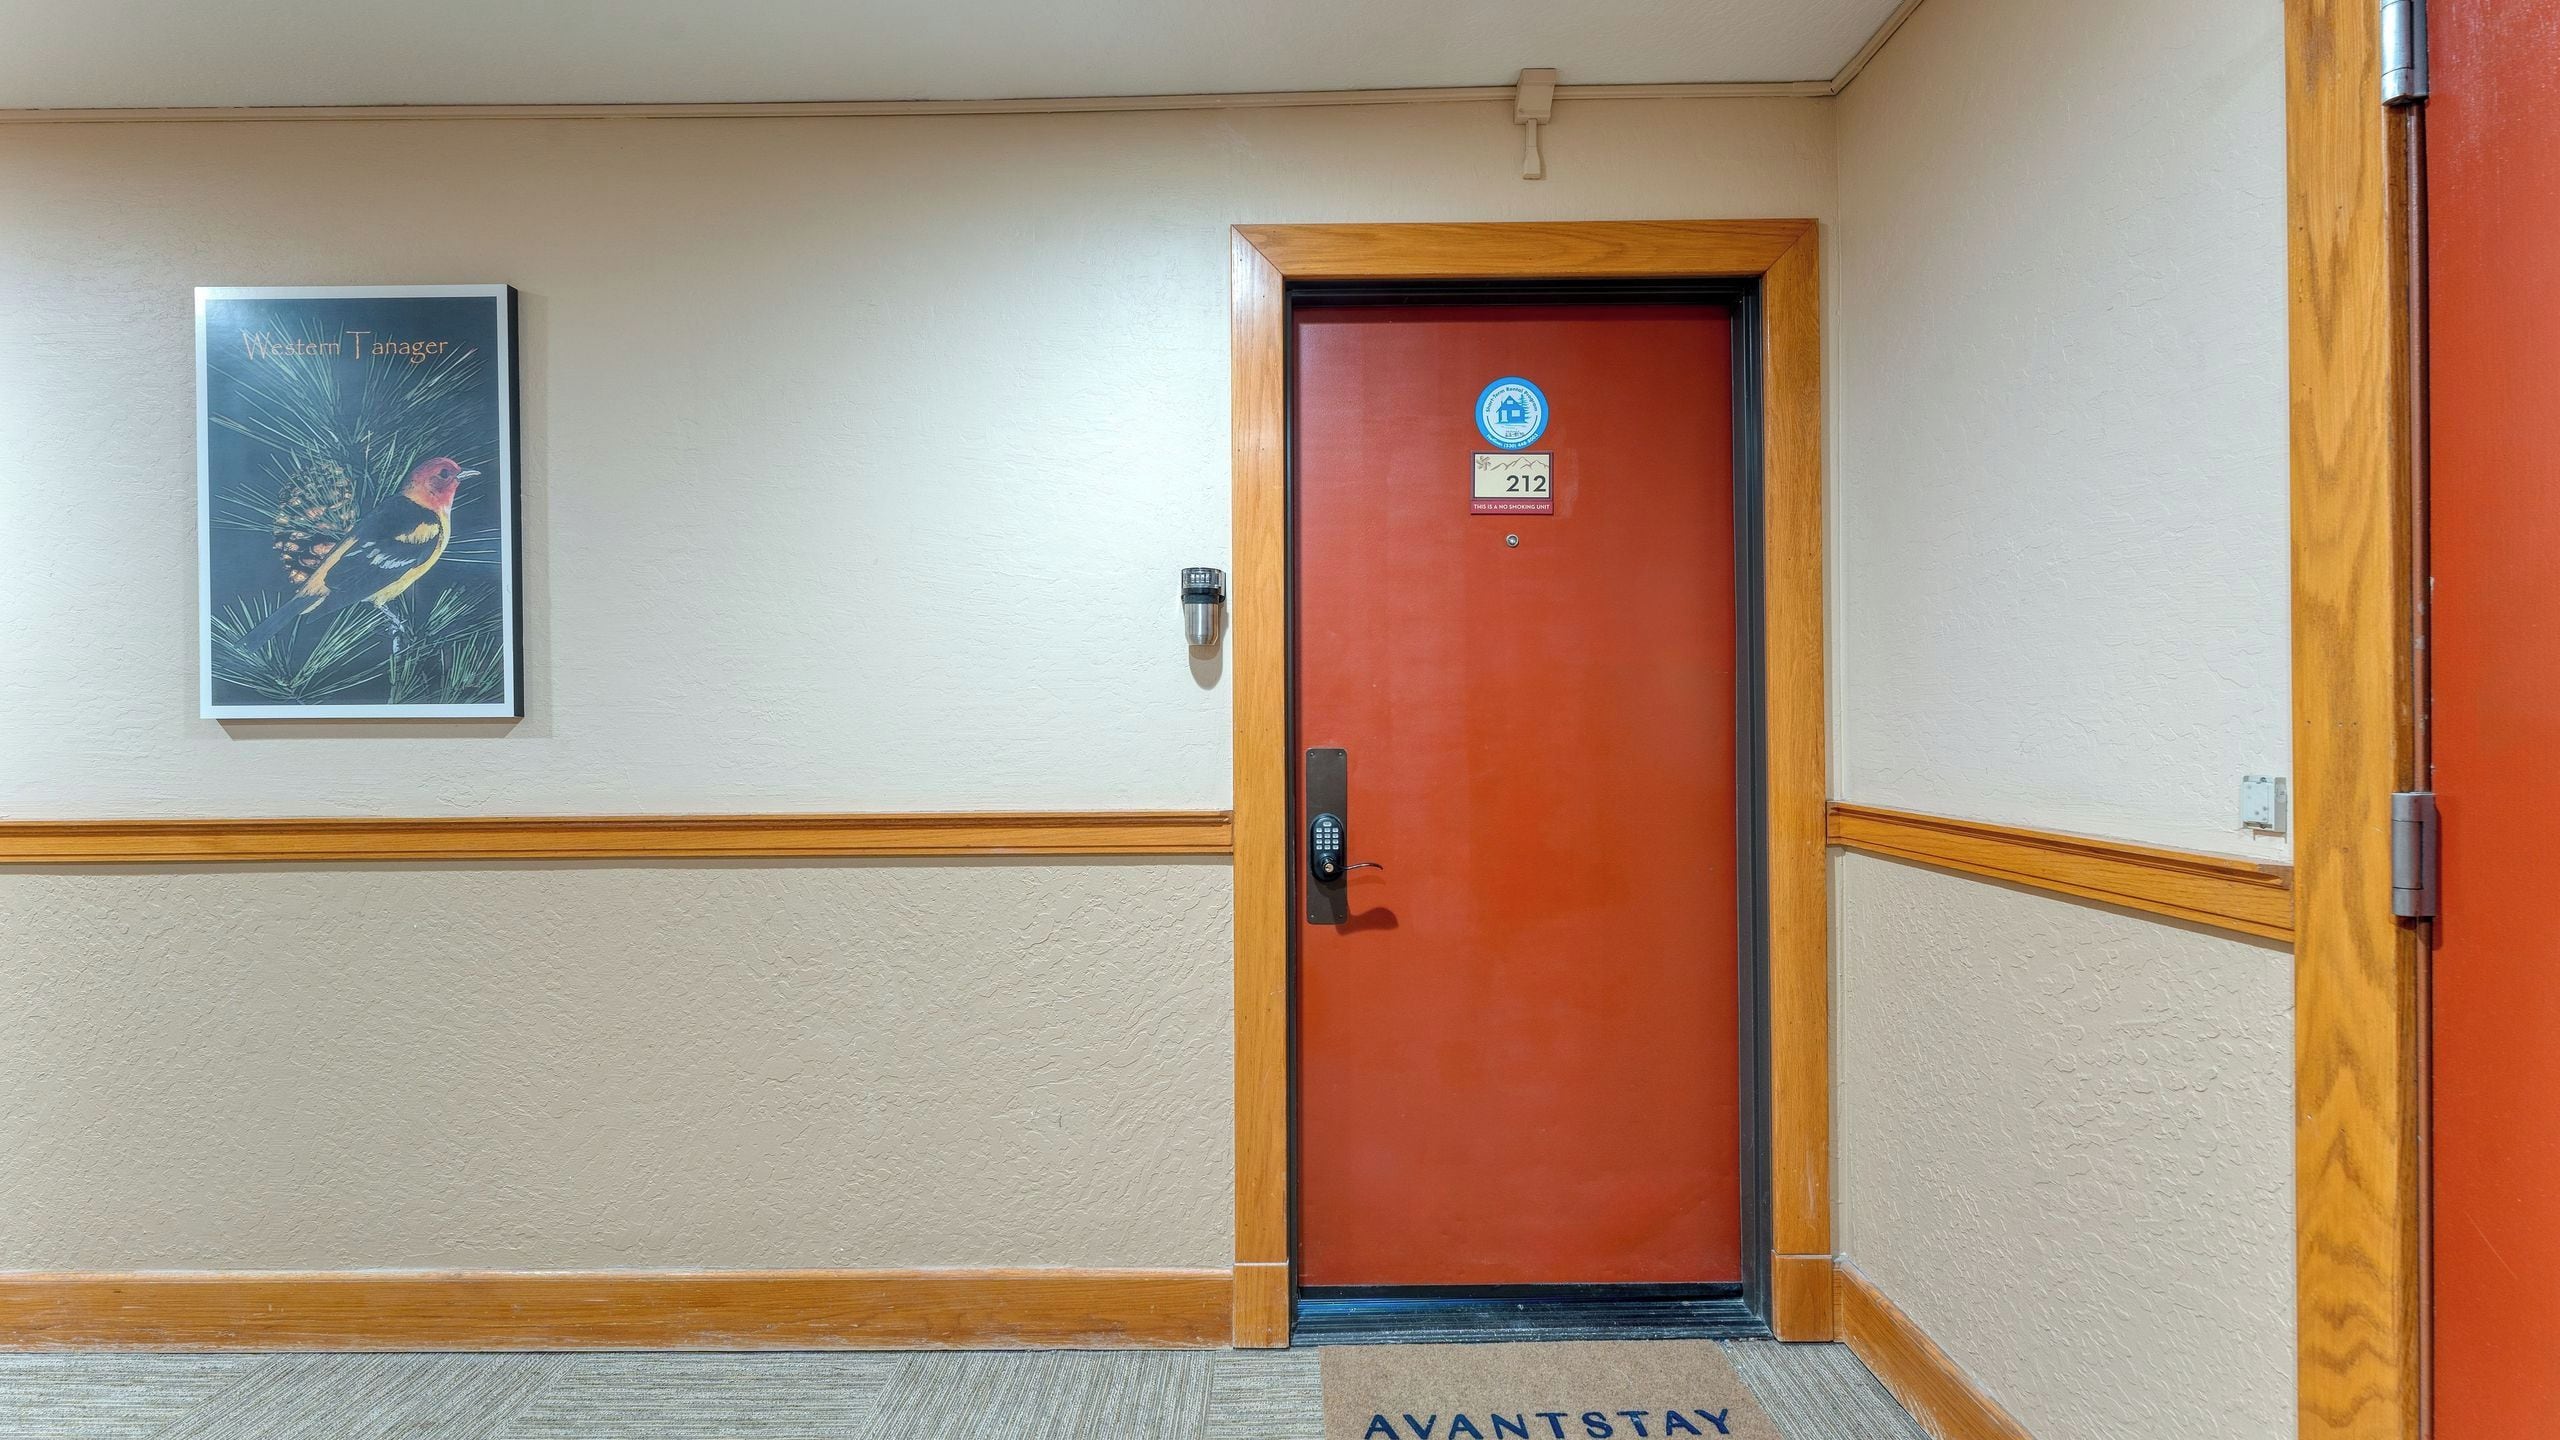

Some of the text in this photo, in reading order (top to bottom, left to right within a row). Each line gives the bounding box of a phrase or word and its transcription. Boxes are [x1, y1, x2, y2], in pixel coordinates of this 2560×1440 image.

[241, 330, 449, 364] Western Tanager
[1523, 390, 1538, 412] Program
[1506, 474, 1547, 492] 212
[1364, 1407, 1731, 1440] AVANTSTAY
